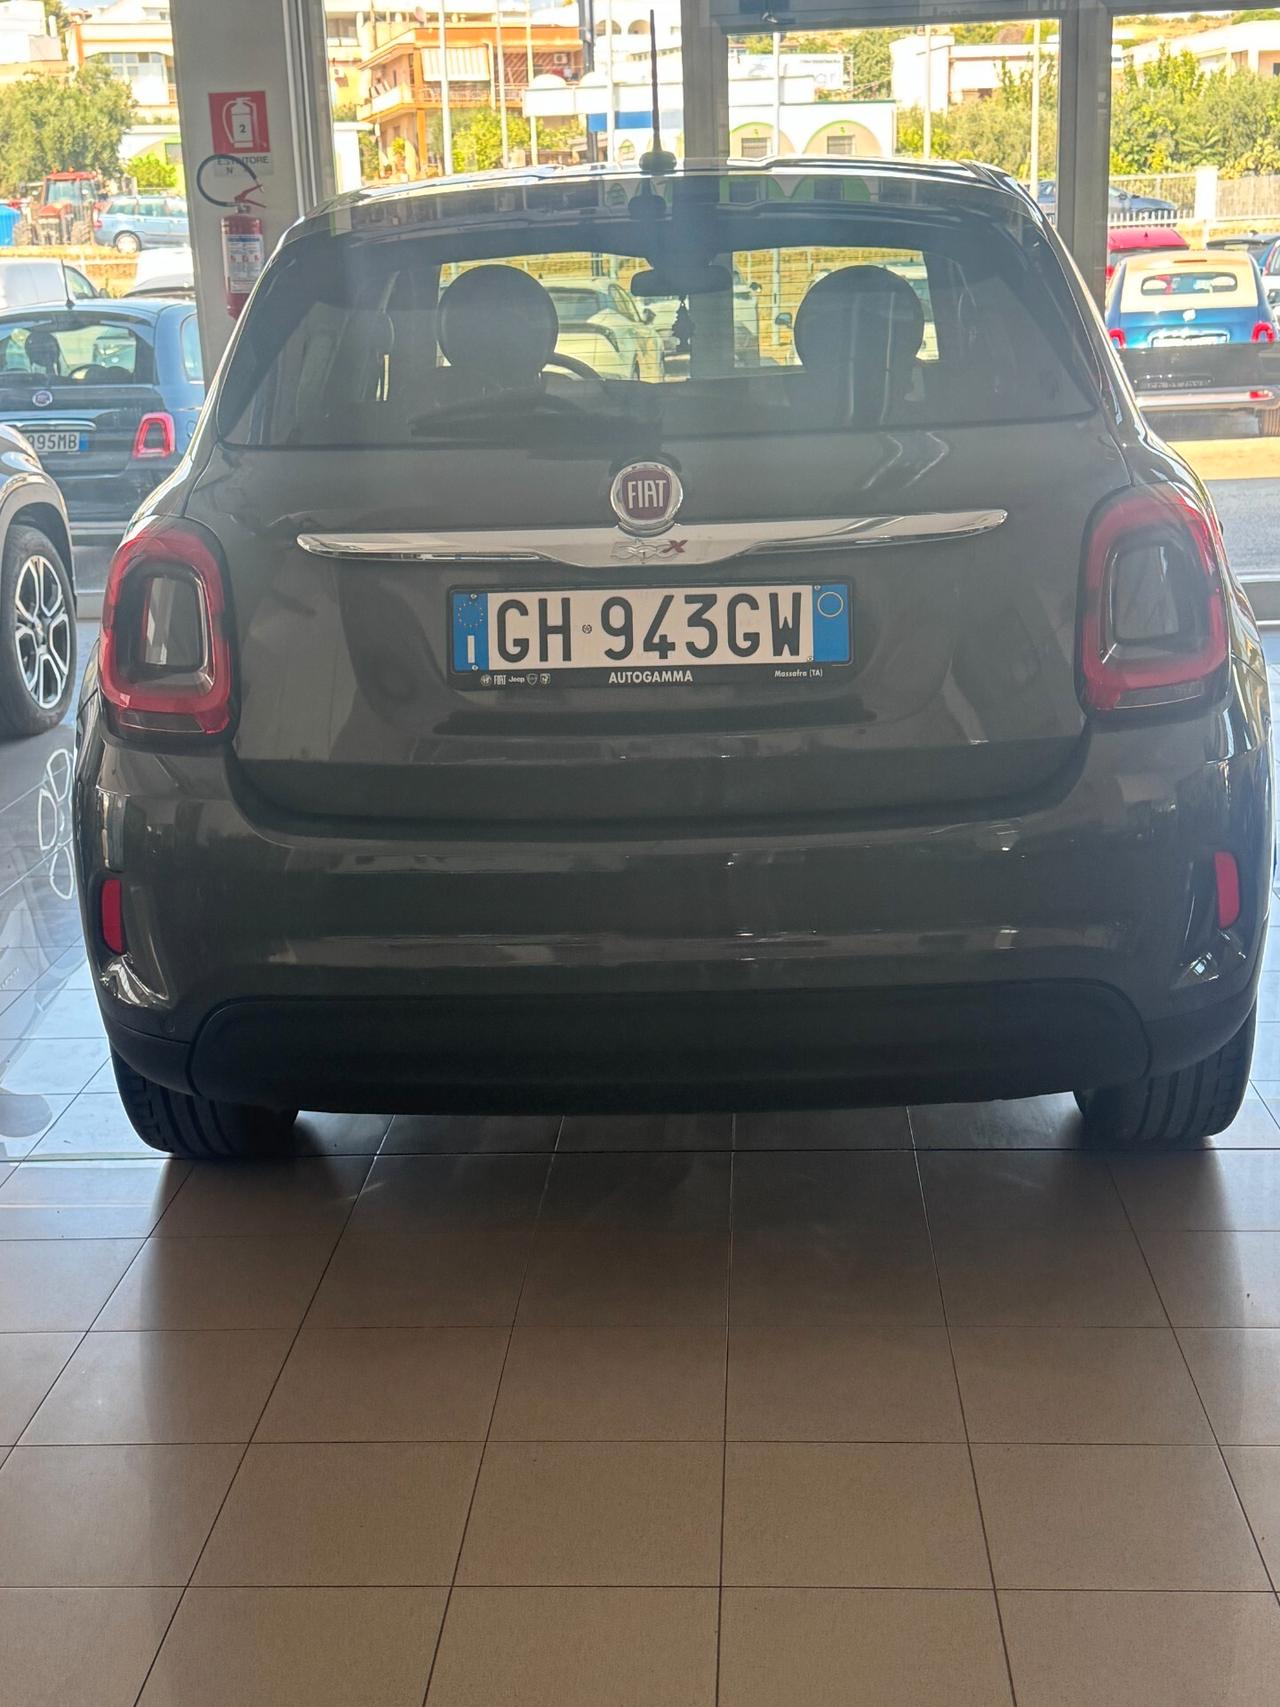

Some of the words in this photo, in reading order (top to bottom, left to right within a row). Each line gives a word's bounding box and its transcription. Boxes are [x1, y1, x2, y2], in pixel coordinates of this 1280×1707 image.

[239, 124, 247, 133] 2
[627, 480, 667, 509] FIAT
[497, 597, 572, 663] GH
[601, 592, 801, 661] 943GW
[608, 670, 694, 685] AUTOGAMMA
[774, 669, 807, 678] Massafra
[809, 668, 824, 678] (TA)
